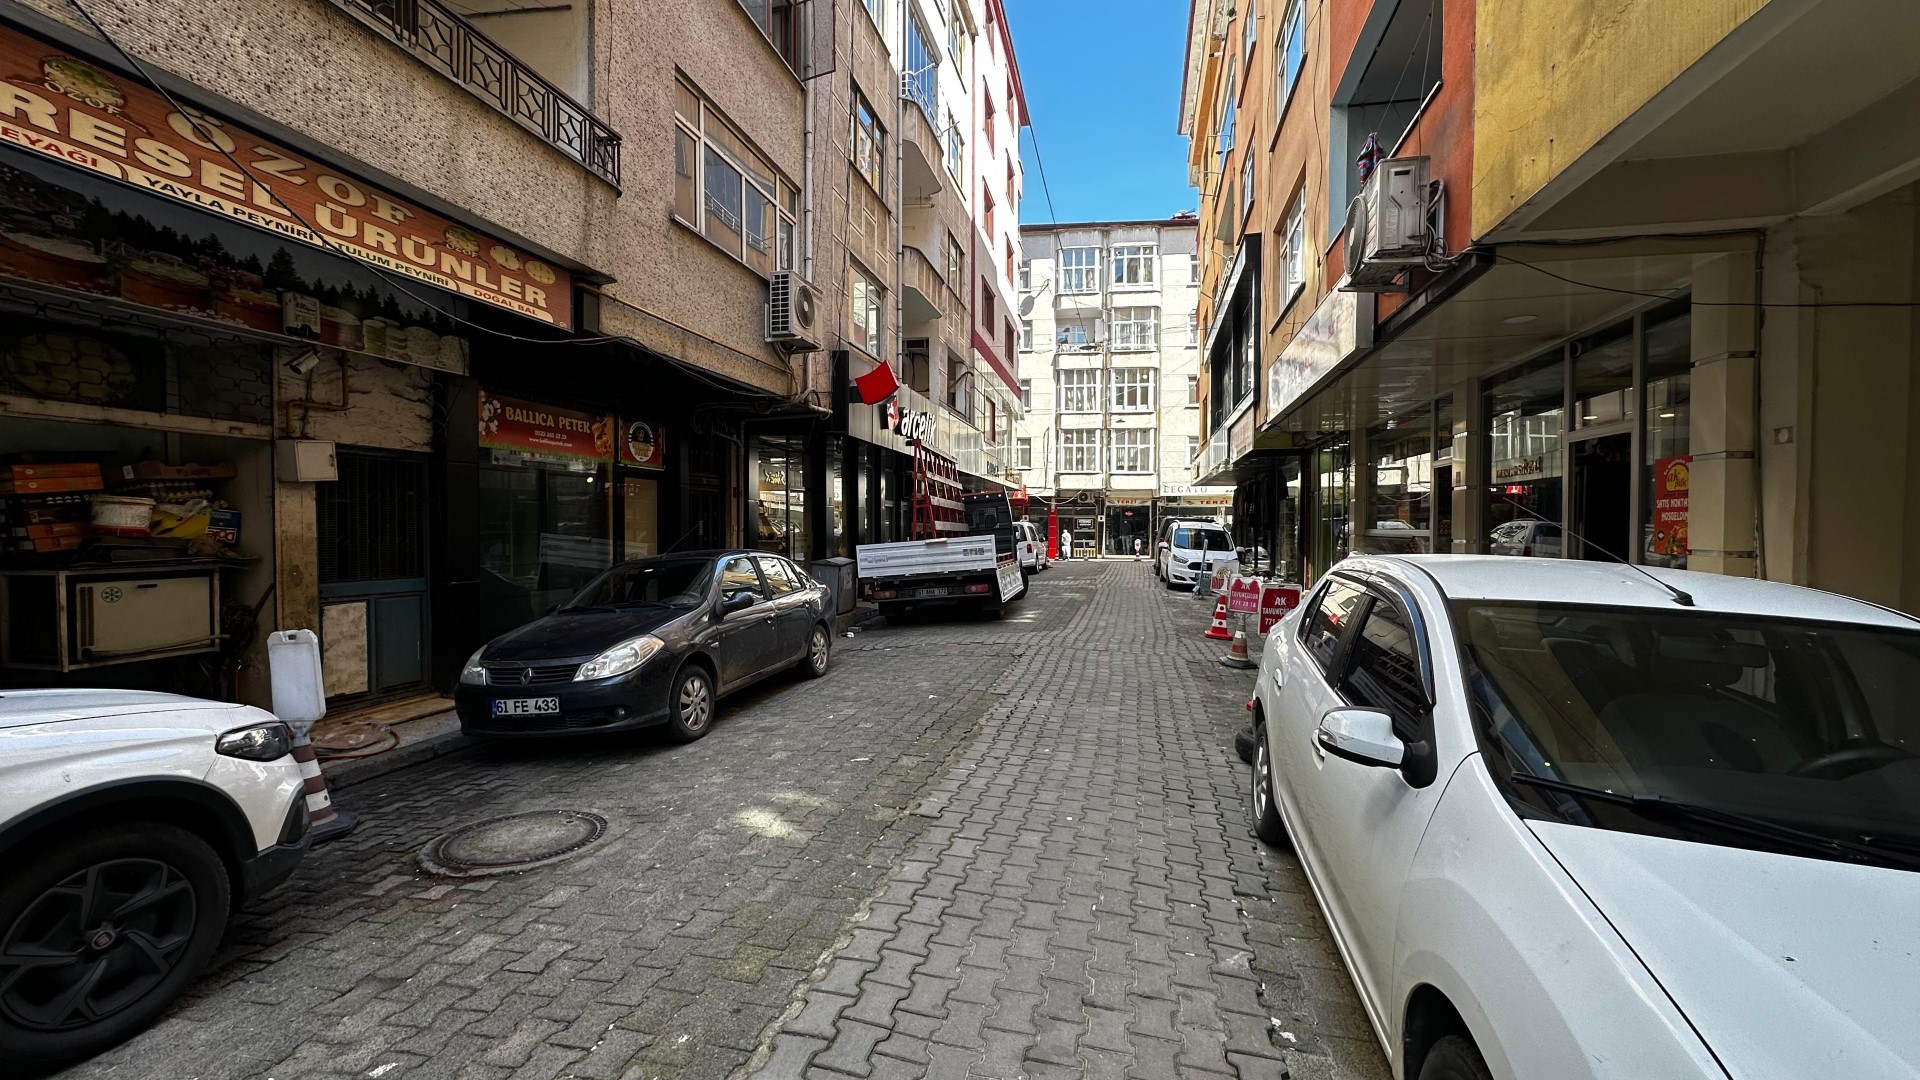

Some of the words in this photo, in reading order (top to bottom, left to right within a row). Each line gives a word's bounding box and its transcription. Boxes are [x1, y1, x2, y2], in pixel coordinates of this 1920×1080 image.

[1, 126, 97, 167] EYAĞI
[166, 104, 416, 225] ÖZOF
[143, 175, 225, 211] YAYLA
[233, 207, 313, 241] PEYNİRİ
[315, 201, 547, 308] ÜRÜNLER
[335, 242, 390, 267] TULUM
[395, 263, 448, 286] PEYNİRİ
[474, 289, 514, 308] DOĞAL
[518, 304, 538, 316] BAL
[505, 406, 554, 428] BALLICA
[559, 416, 590, 434] PETEK
[1670, 498, 1688, 508] NOKTA
[1274, 597, 1286, 605] AK
[496, 701, 509, 713] 61
[513, 700, 529, 713] FE
[534, 699, 557, 712] 433
